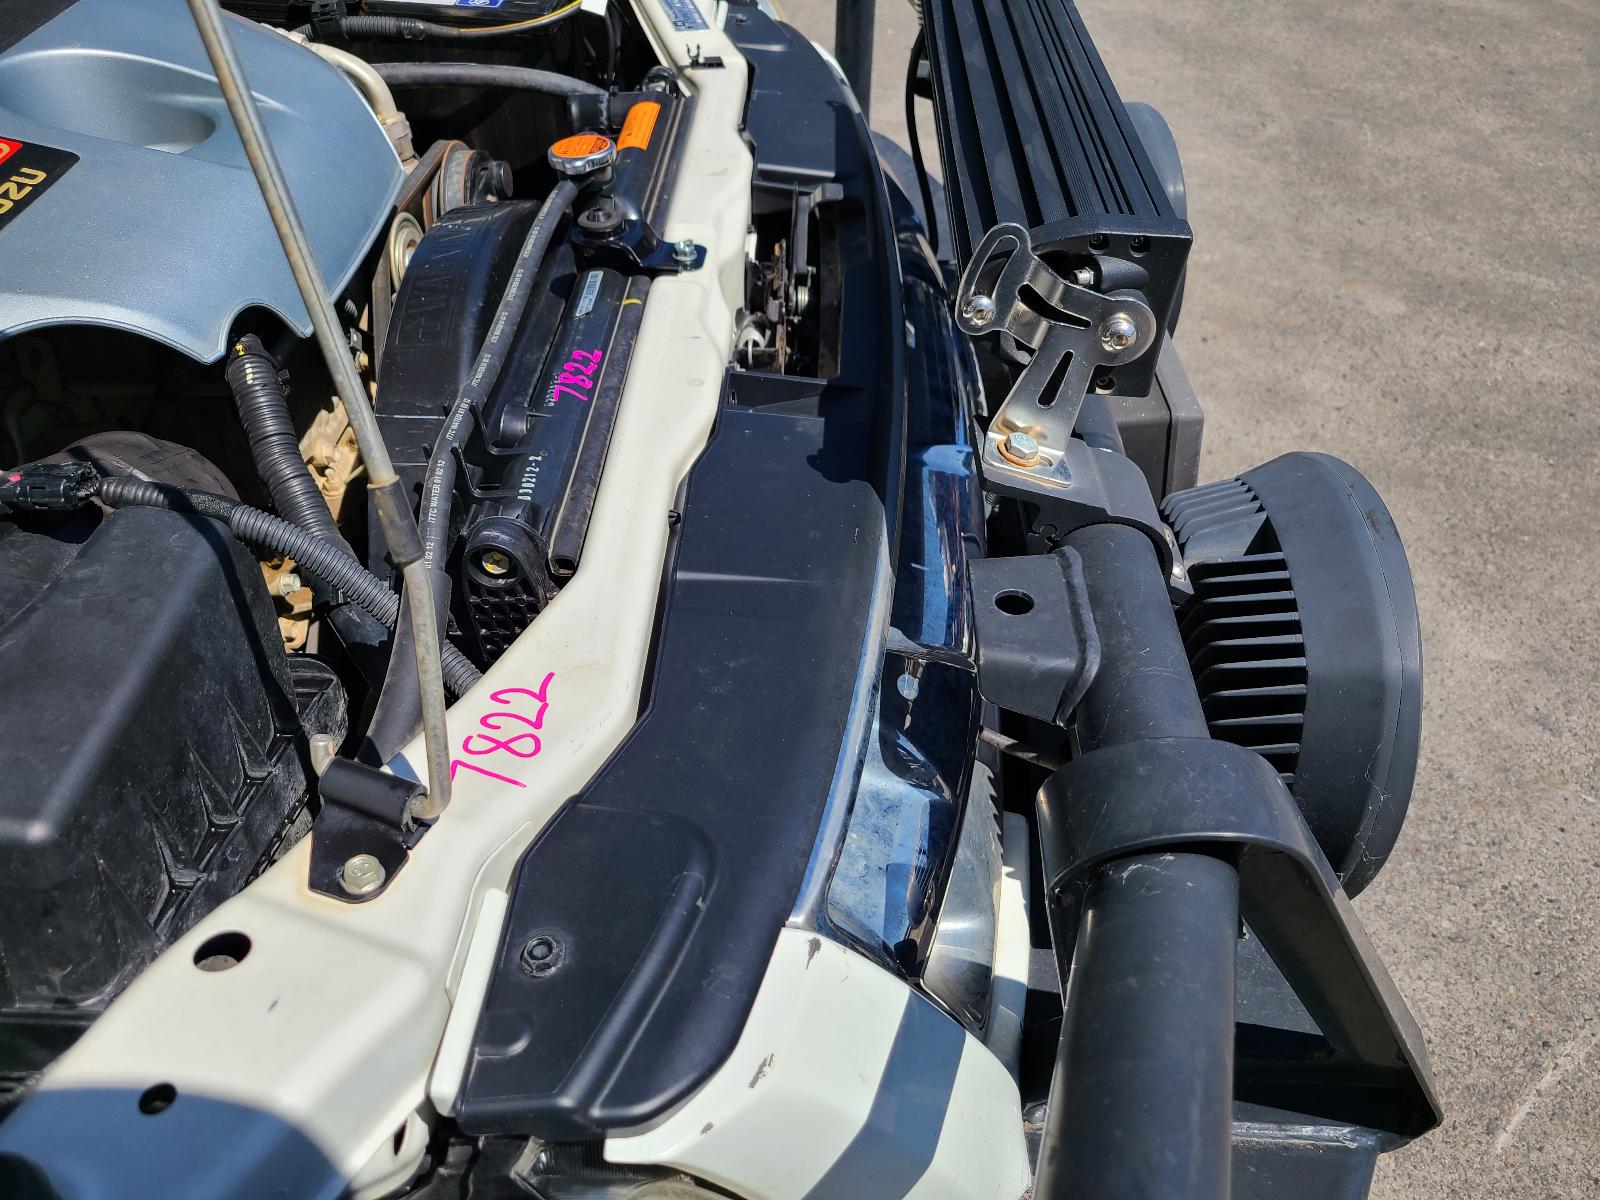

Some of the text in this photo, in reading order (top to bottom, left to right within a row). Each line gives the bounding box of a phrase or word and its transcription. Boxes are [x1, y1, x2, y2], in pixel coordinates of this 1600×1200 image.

[553, 349, 603, 401] 7822
[429, 482, 441, 508] WATER
[449, 671, 556, 788] 7822
